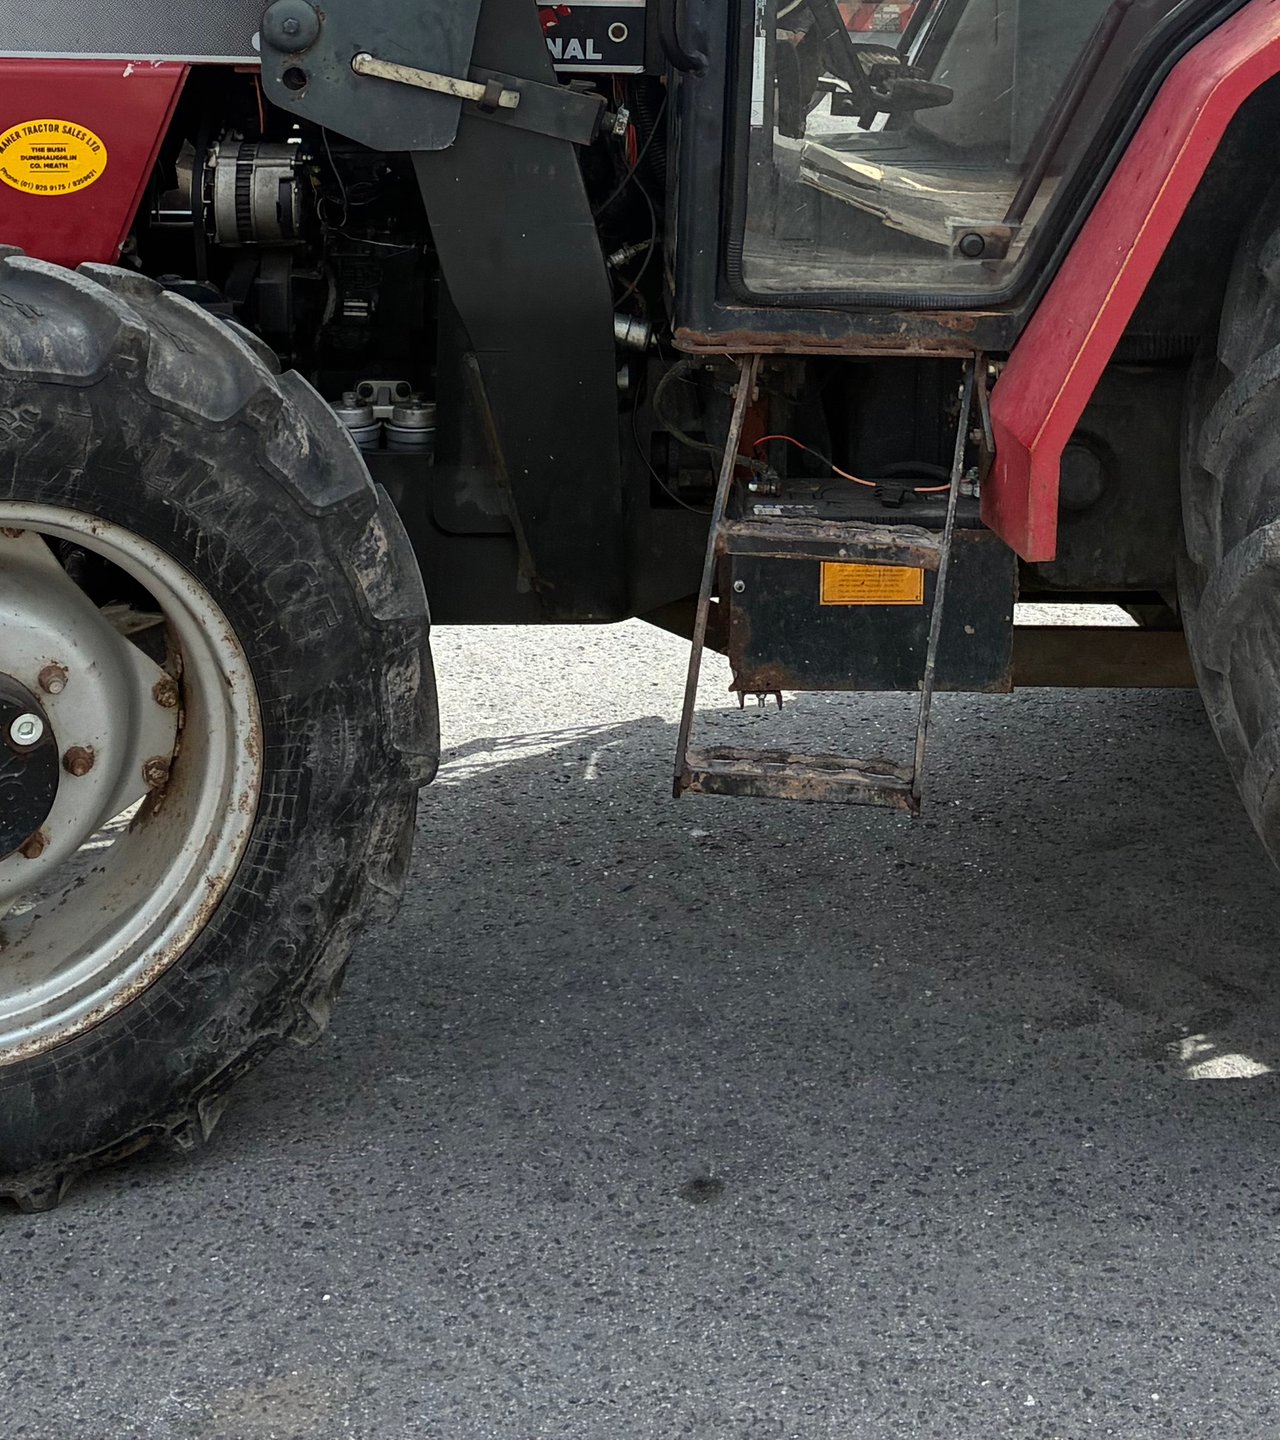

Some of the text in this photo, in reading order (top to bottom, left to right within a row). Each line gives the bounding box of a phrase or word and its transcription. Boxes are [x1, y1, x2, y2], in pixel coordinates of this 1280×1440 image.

[22, 123, 60, 137] TRACTOR
[61, 125, 87, 142] SALES
[85, 137, 101, 155] LTD.
[0, 166, 20, 185] Phone:
